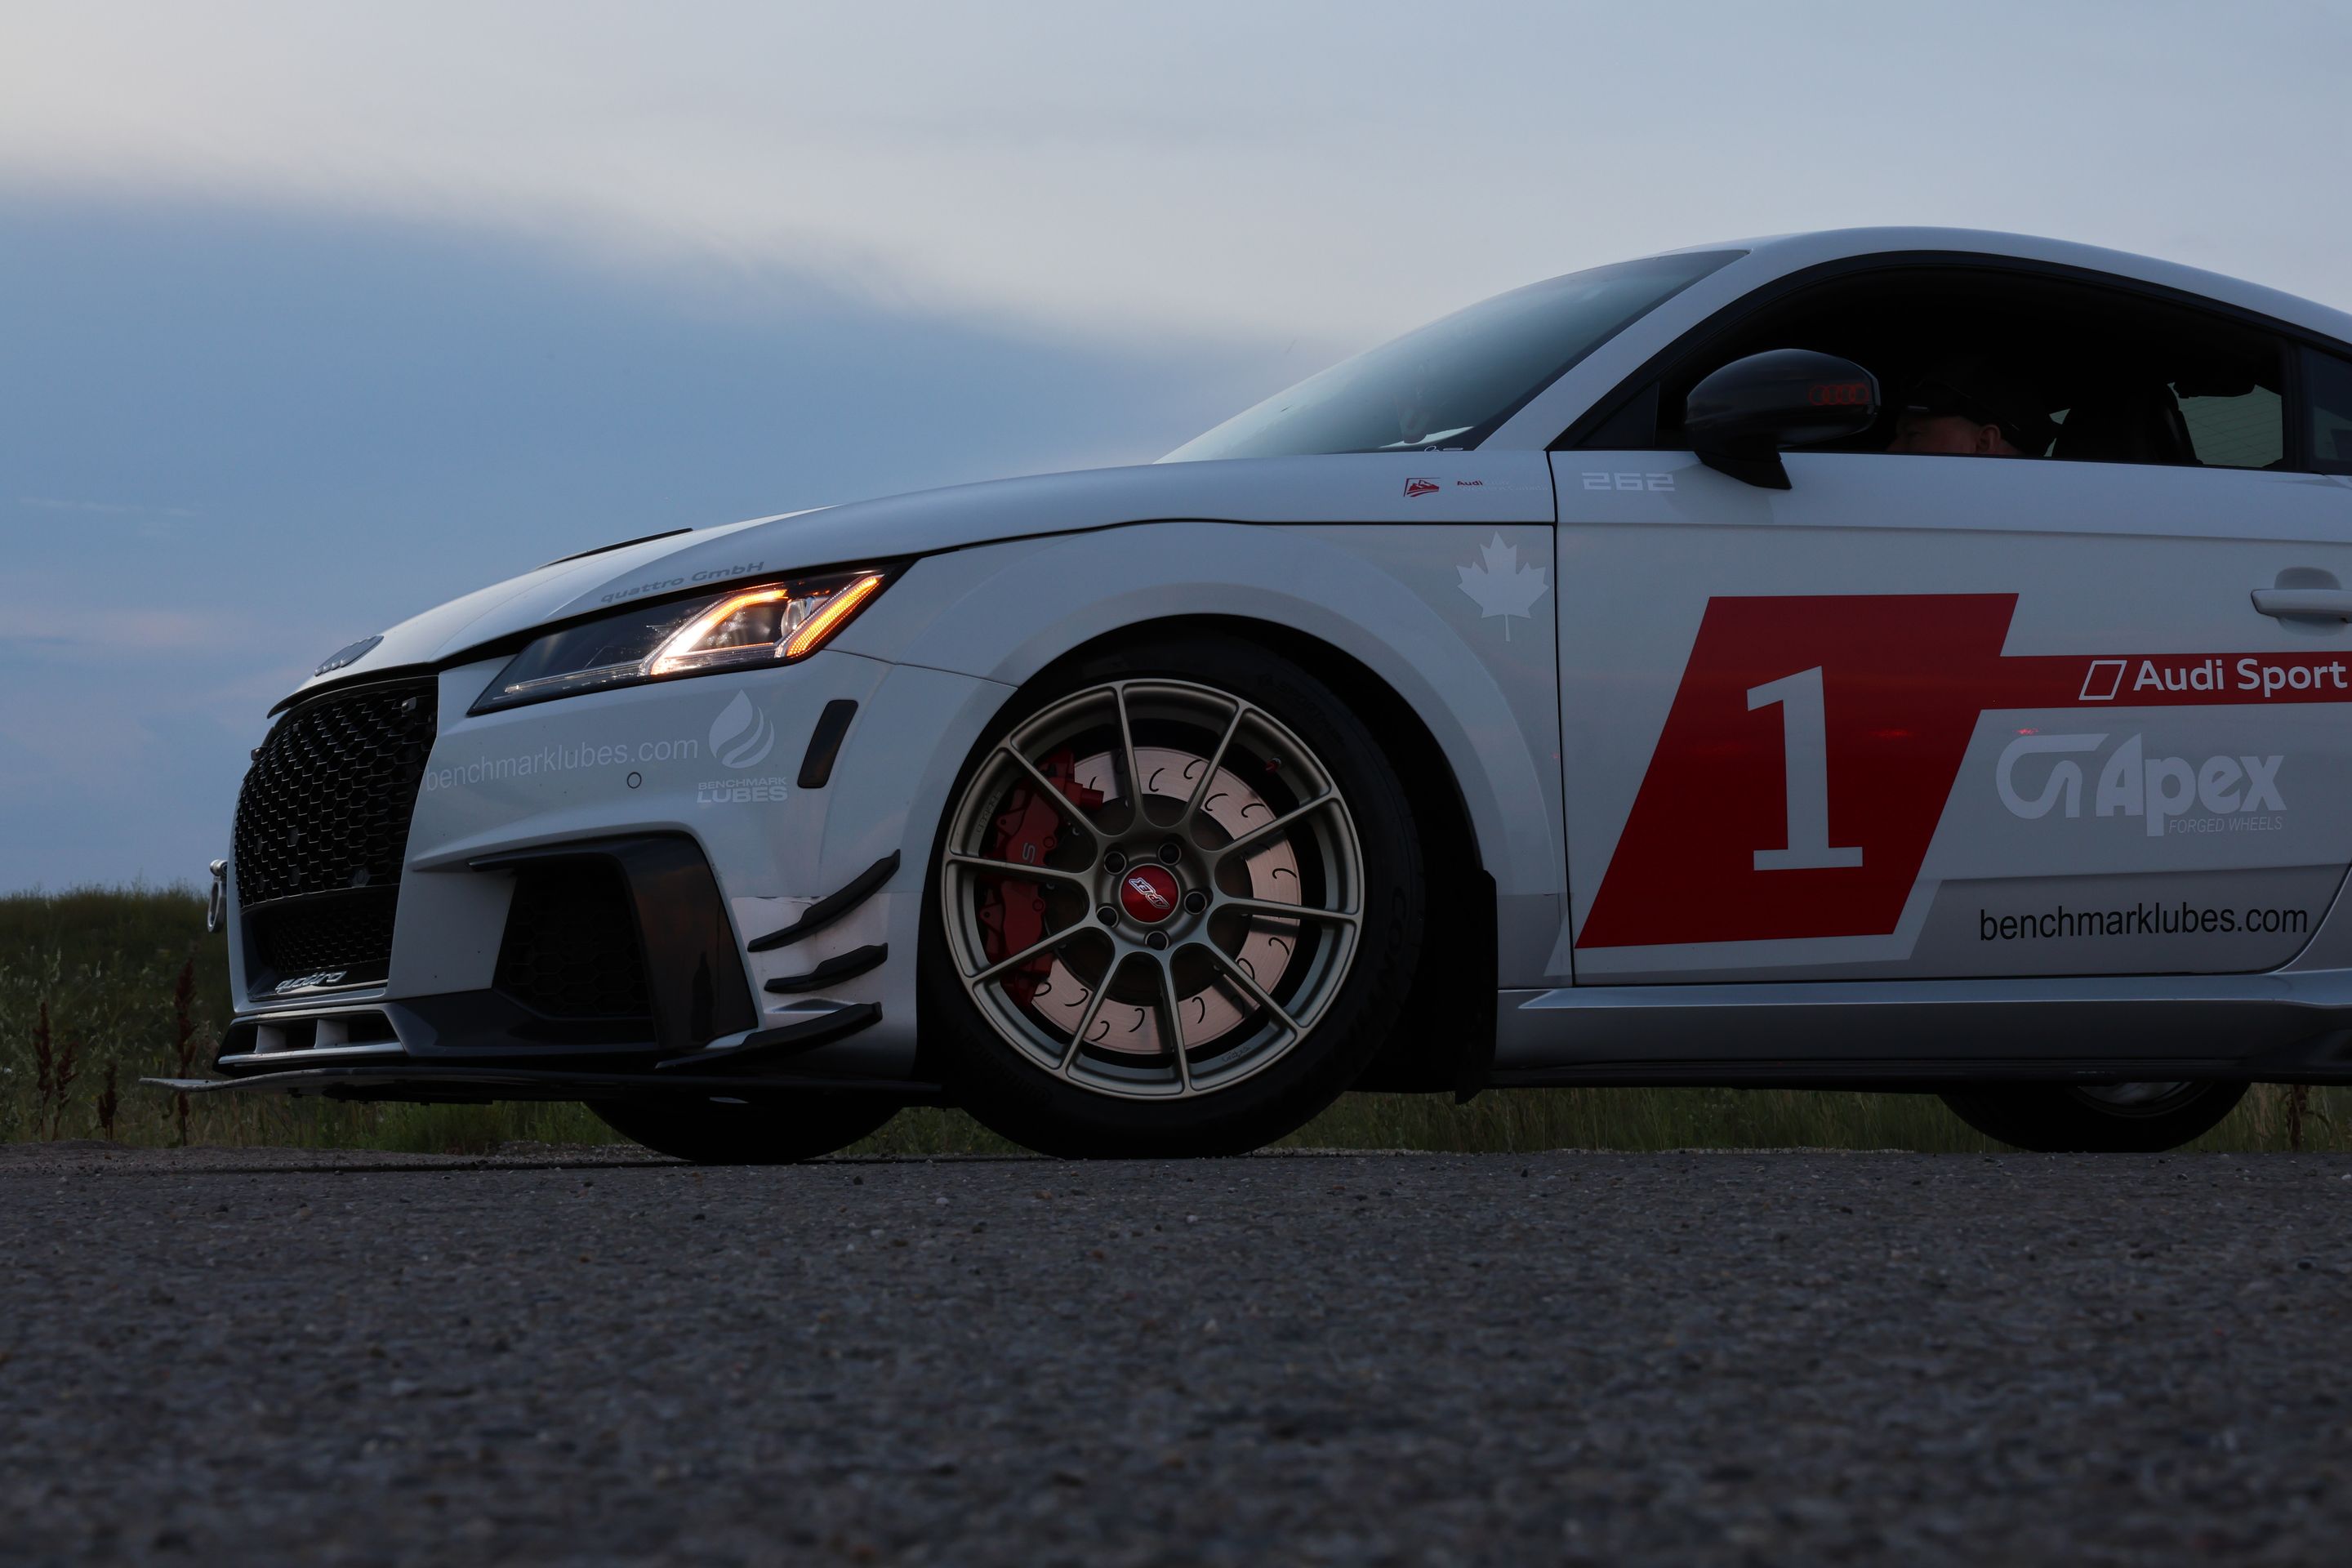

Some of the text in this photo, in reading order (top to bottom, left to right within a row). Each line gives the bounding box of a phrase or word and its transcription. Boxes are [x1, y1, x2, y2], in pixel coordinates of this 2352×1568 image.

[601, 561, 764, 604] quattro GmbH
[2133, 657, 2348, 697] Audi Sport
[425, 738, 698, 791] benchmarklubes.com
[698, 777, 787, 791] BENCHMARK
[1747, 666, 1863, 871] 1
[697, 786, 788, 804] LUBES
[2096, 733, 2287, 837] Apex
[2169, 816, 2283, 834] FORGED WHEELS
[1129, 877, 1169, 909] APEX
[1980, 902, 2309, 941] benchmarklubes.com
[275, 969, 347, 994] quattro
